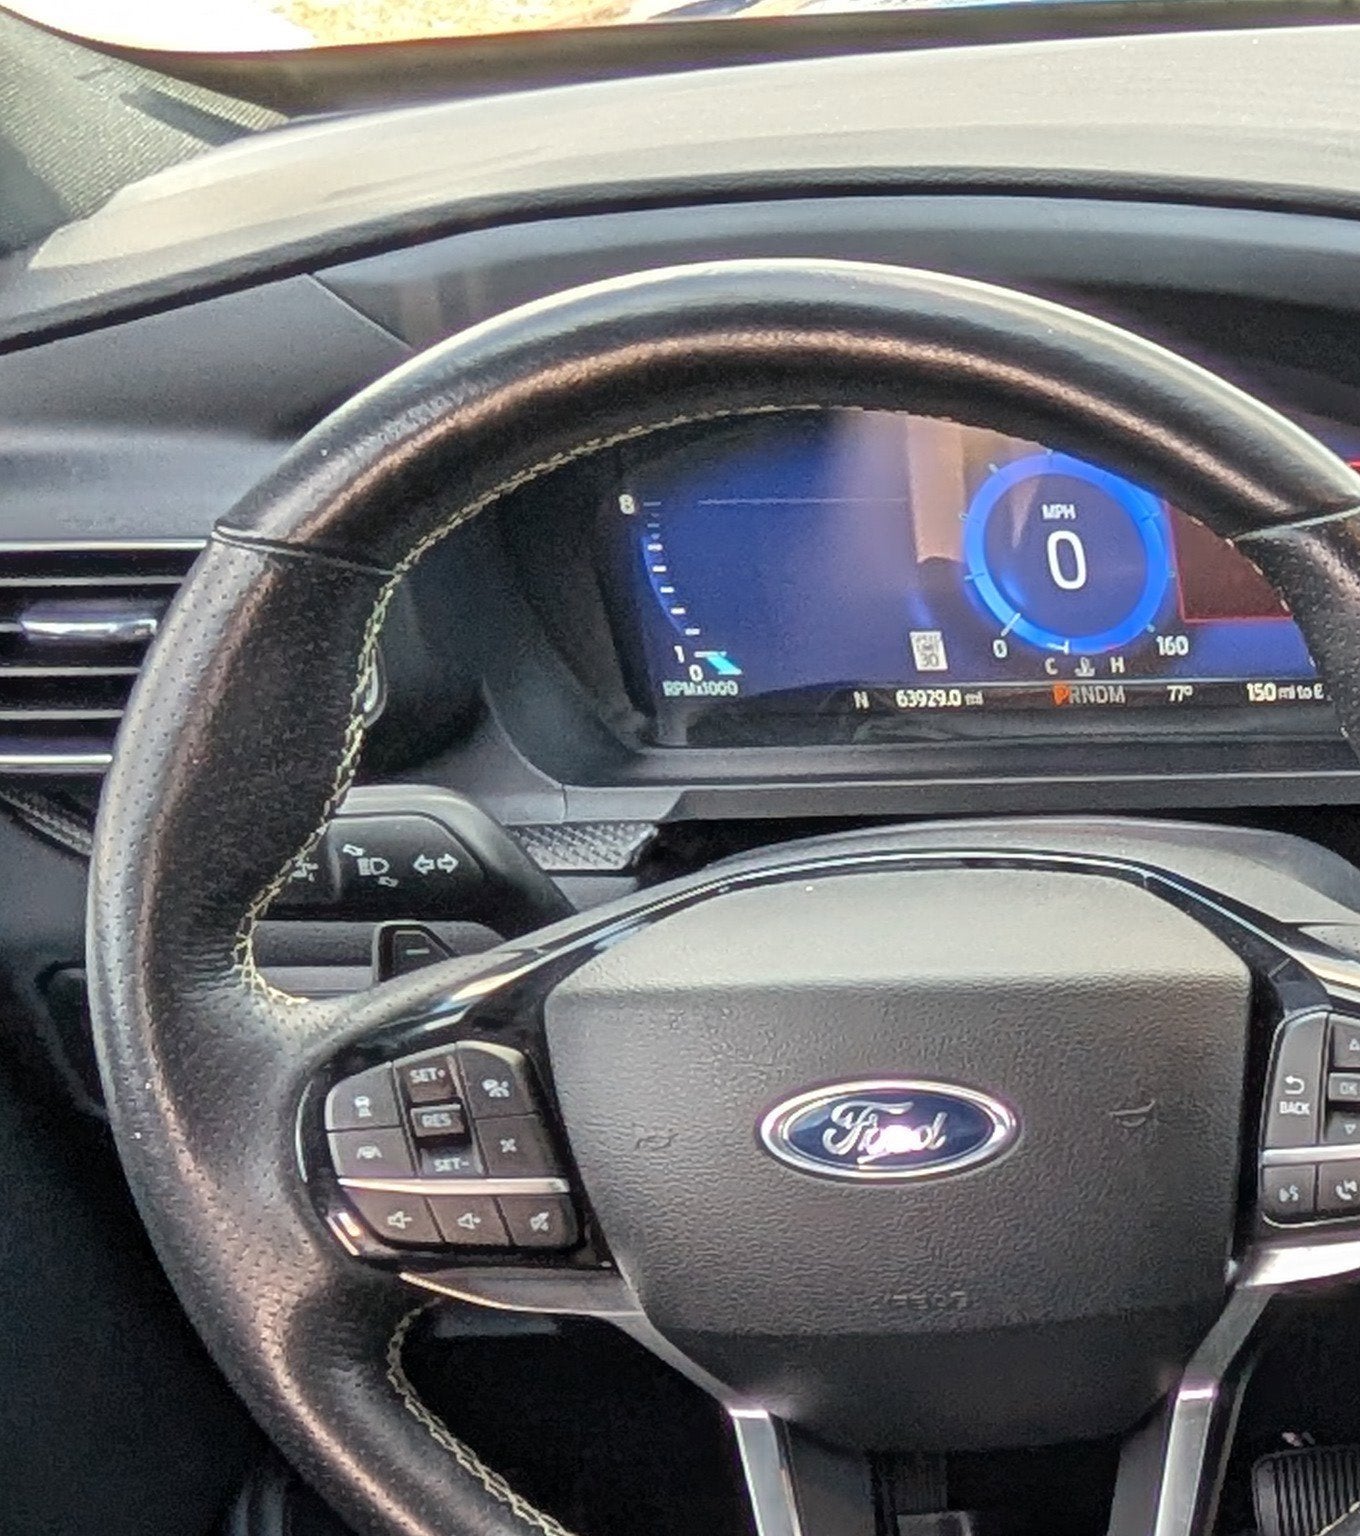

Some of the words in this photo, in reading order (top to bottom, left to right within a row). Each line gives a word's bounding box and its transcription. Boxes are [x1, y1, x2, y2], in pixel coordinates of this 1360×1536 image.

[1042, 504, 1076, 520] MPH
[1047, 530, 1087, 590] 0
[992, 639, 1008, 659] 0
[1155, 635, 1190, 656] 160
[1110, 656, 1125, 674] H
[854, 691, 870, 709] N
[896, 689, 963, 708] 63929.0
[1246, 683, 1277, 702] 150
[1339, 1082, 1359, 1097] OK
[1279, 1102, 1311, 1116] BACK
[421, 1113, 451, 1128] RES
[822, 1100, 947, 1164] Fod
